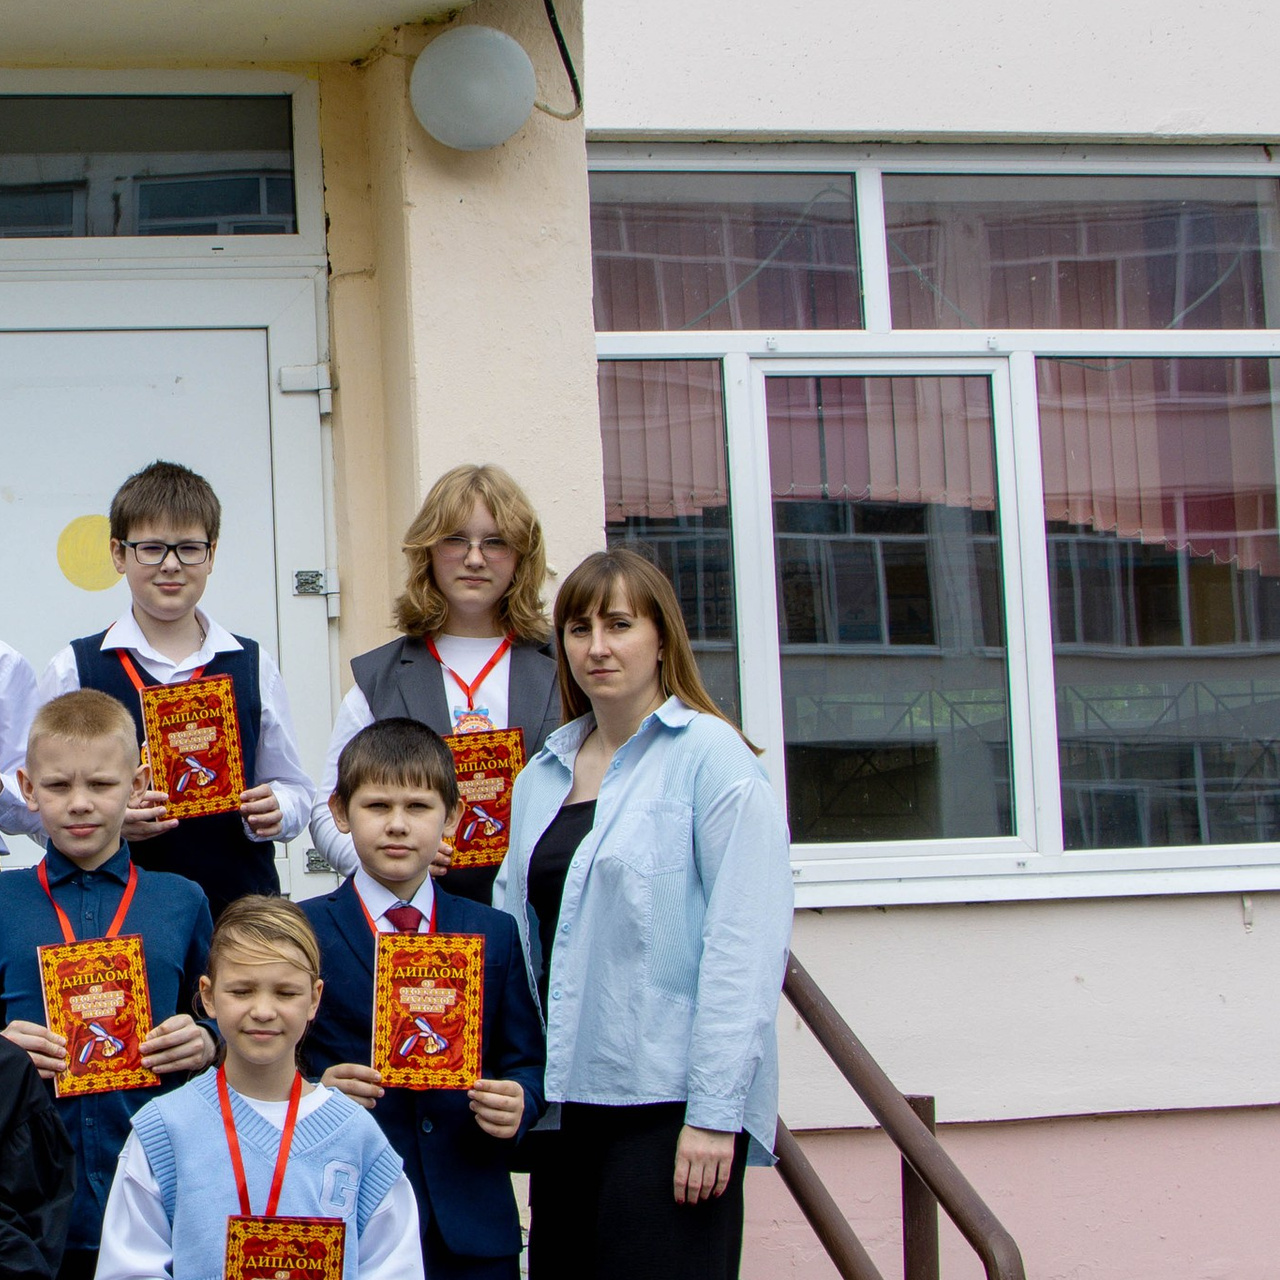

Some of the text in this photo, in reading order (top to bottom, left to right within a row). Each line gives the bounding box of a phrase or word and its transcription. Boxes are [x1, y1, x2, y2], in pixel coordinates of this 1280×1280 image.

[162, 708, 220, 727] ДИПЛОМ
[455, 759, 509, 774] ИПЛОМ
[62, 970, 129, 989] ДИПЛОМ
[395, 966, 464, 979] ДИПЛОМ
[319, 1158, 360, 1219] G
[246, 1255, 322, 1270] ДИПЛОМ
